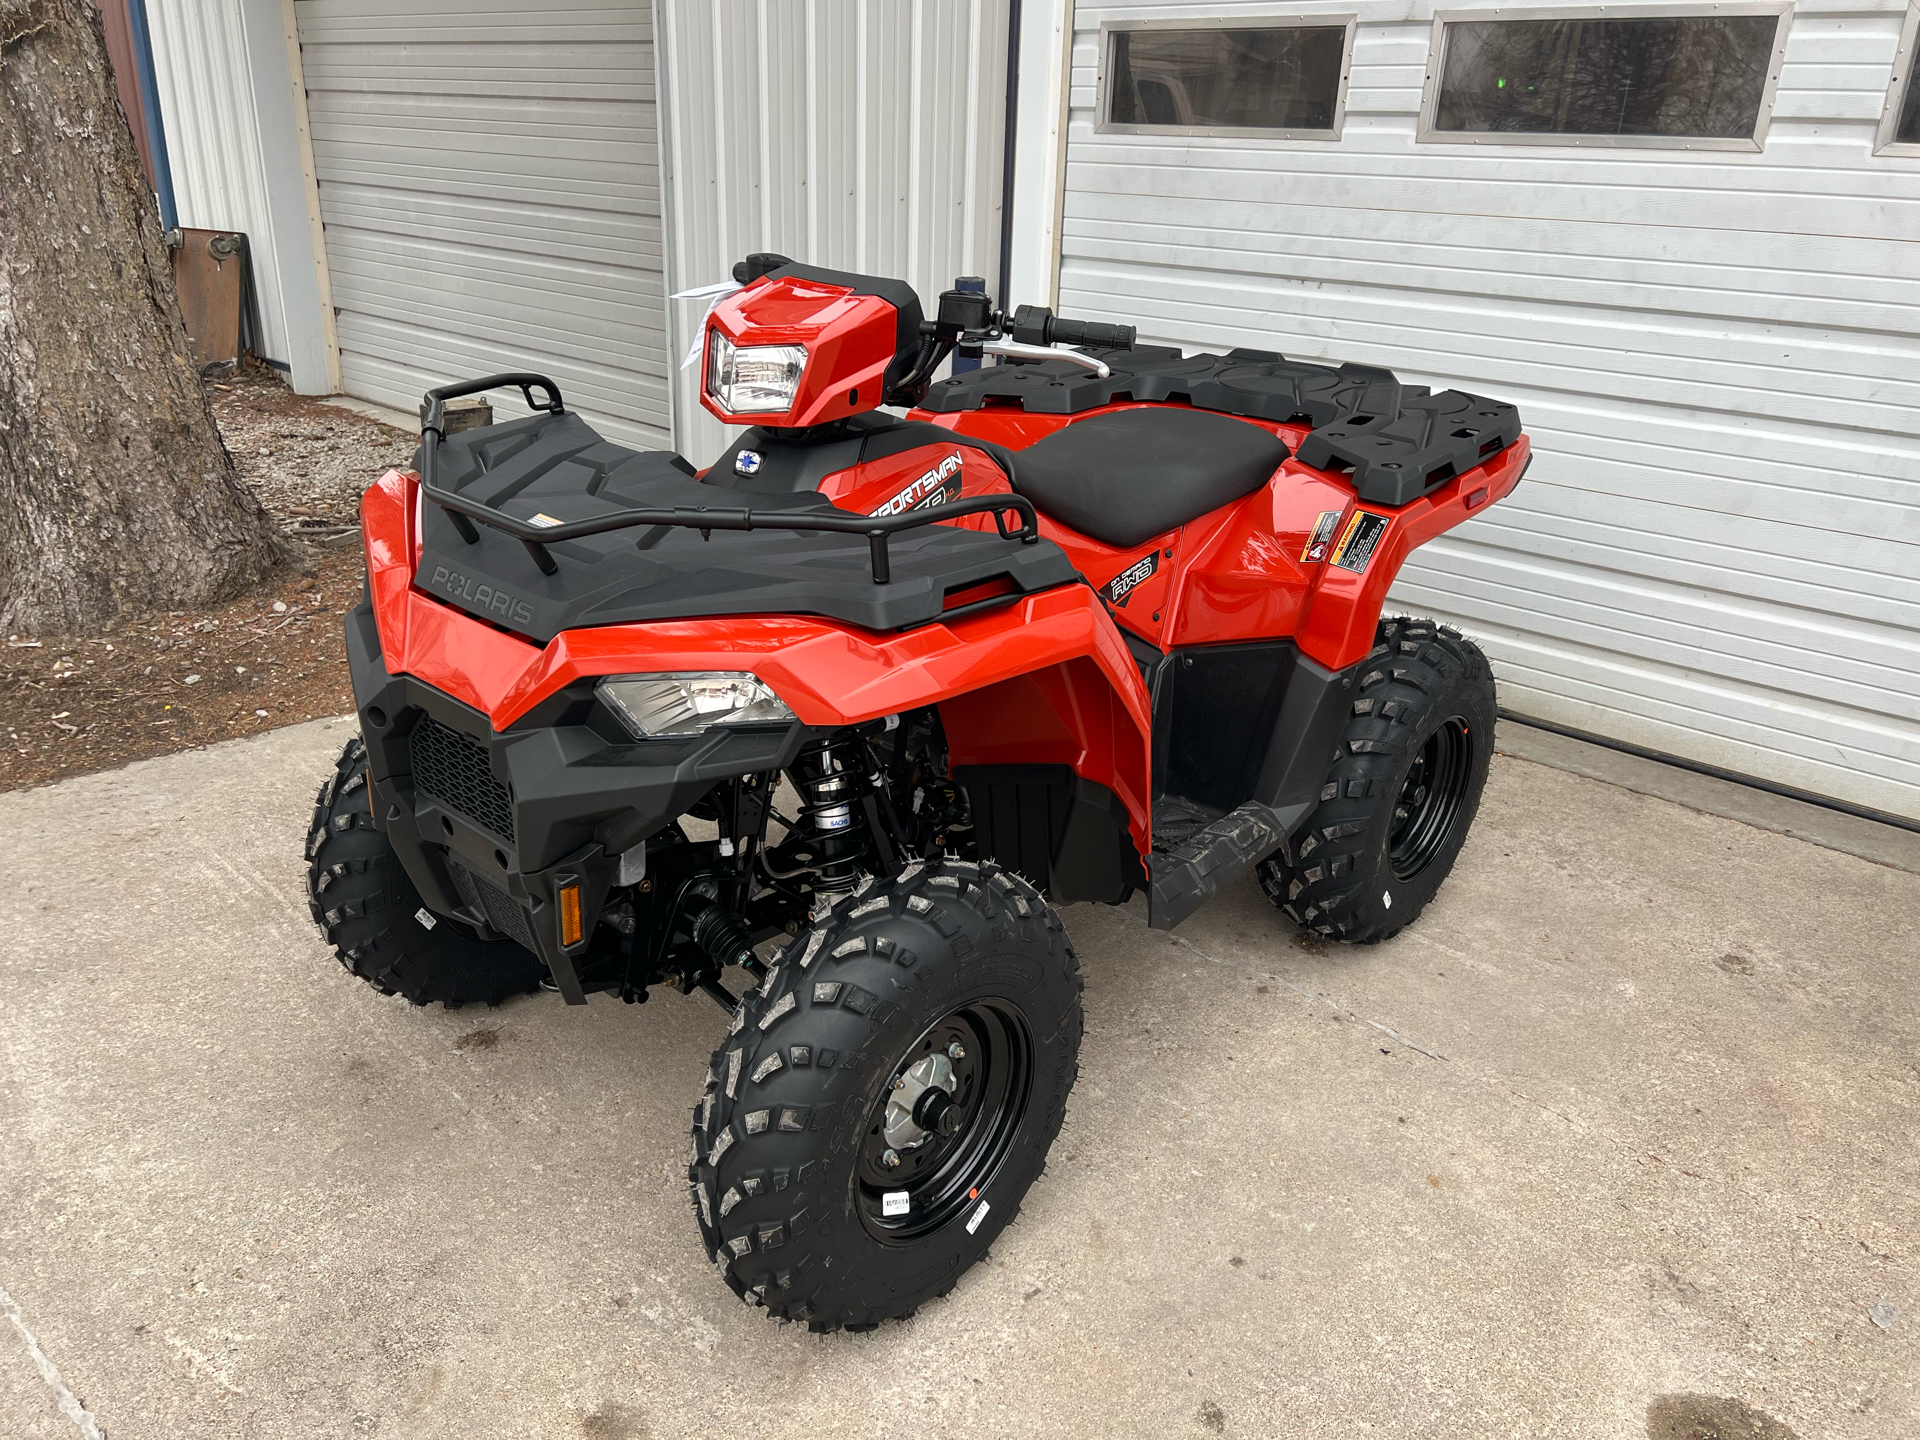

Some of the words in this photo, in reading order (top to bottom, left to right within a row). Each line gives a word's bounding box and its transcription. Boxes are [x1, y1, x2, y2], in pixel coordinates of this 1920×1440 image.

[431, 564, 534, 626] POLARIS
[1112, 563, 1153, 601] AWD
[830, 819, 849, 827] SACHS
